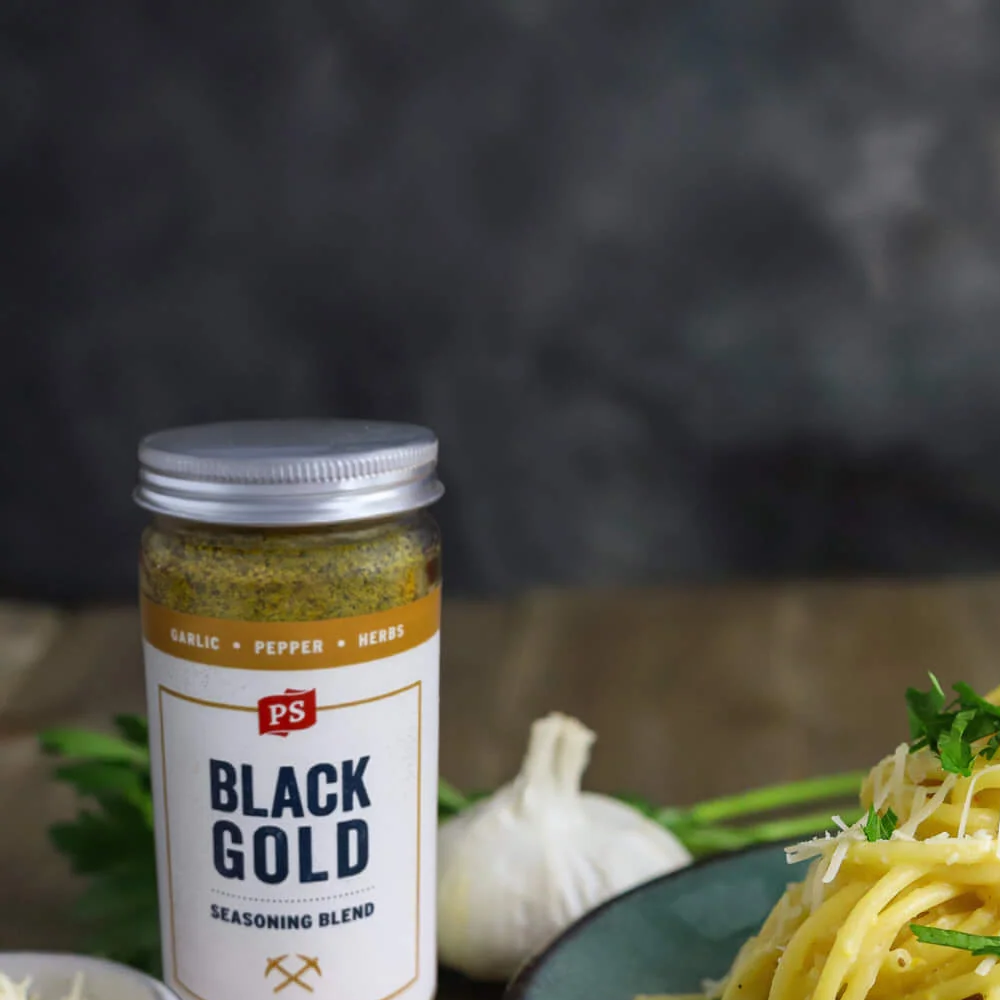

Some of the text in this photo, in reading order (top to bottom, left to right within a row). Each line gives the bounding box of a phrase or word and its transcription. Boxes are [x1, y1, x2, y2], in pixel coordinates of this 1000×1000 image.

[170, 624, 405, 655] GARLIC PEPPER HERBS
[268, 700, 306, 726] PS
[209, 756, 371, 818] BLACK
[212, 818, 369, 885] GOLD
[210, 902, 375, 930] SEASONING BLEND
